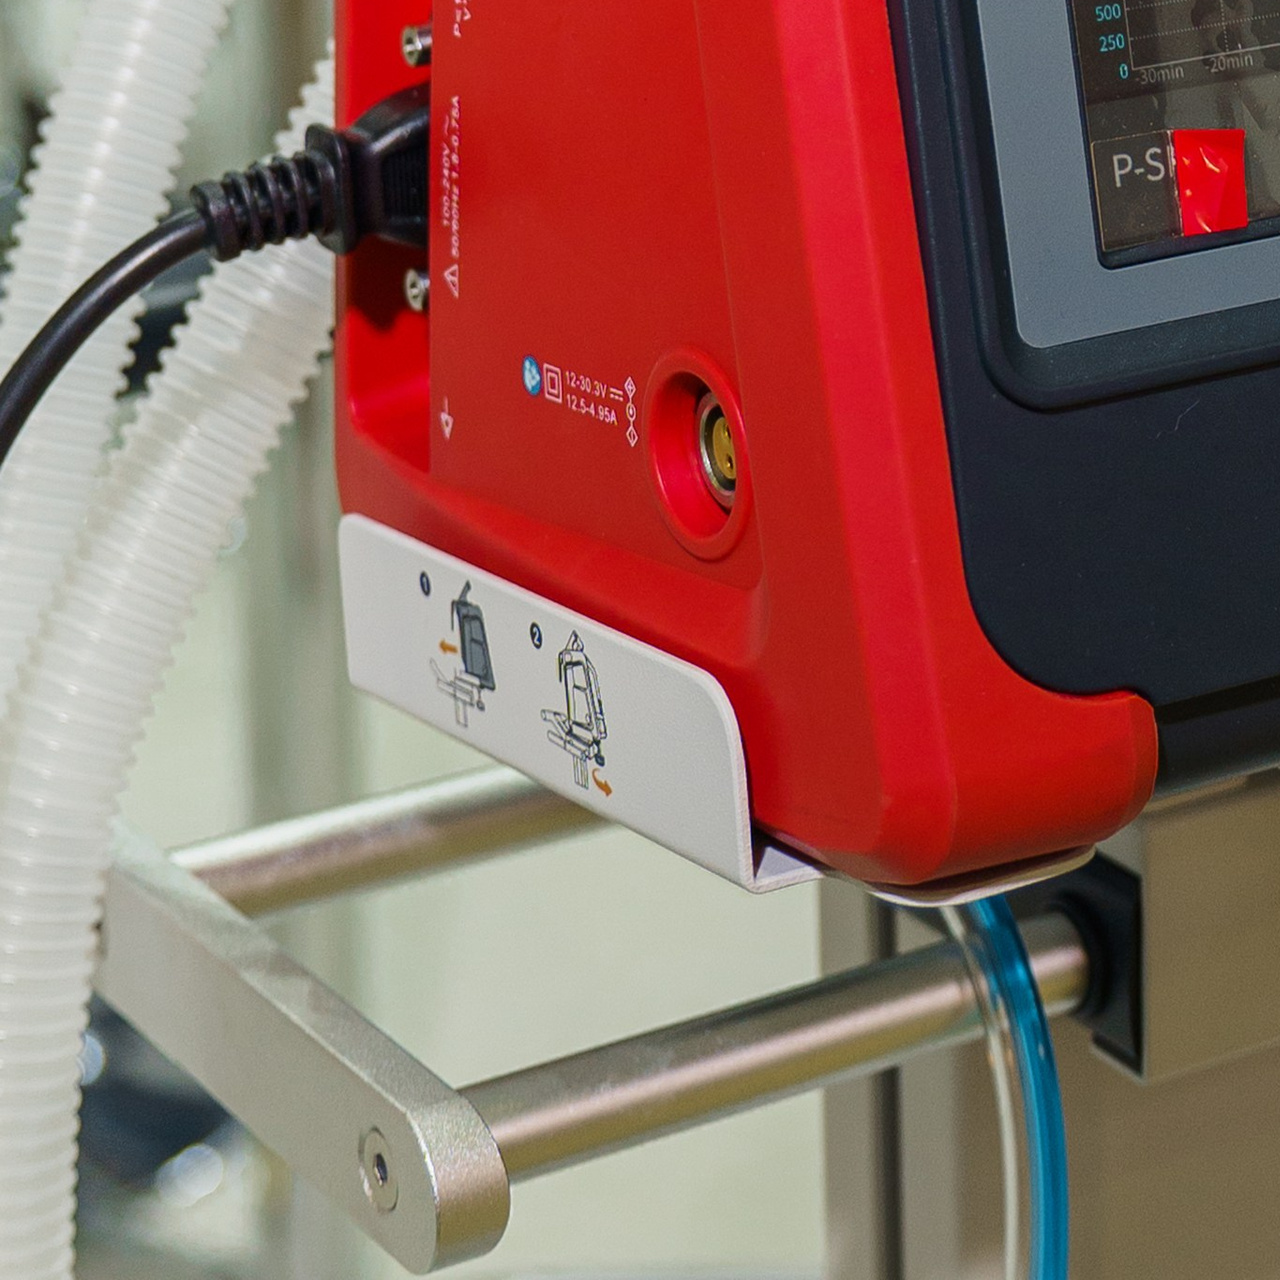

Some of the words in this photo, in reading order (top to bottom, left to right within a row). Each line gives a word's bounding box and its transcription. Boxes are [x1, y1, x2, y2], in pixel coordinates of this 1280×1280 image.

[1096, 4, 1121, 20] 500
[1099, 34, 1124, 51] 250
[1120, 64, 1128, 79] 0
